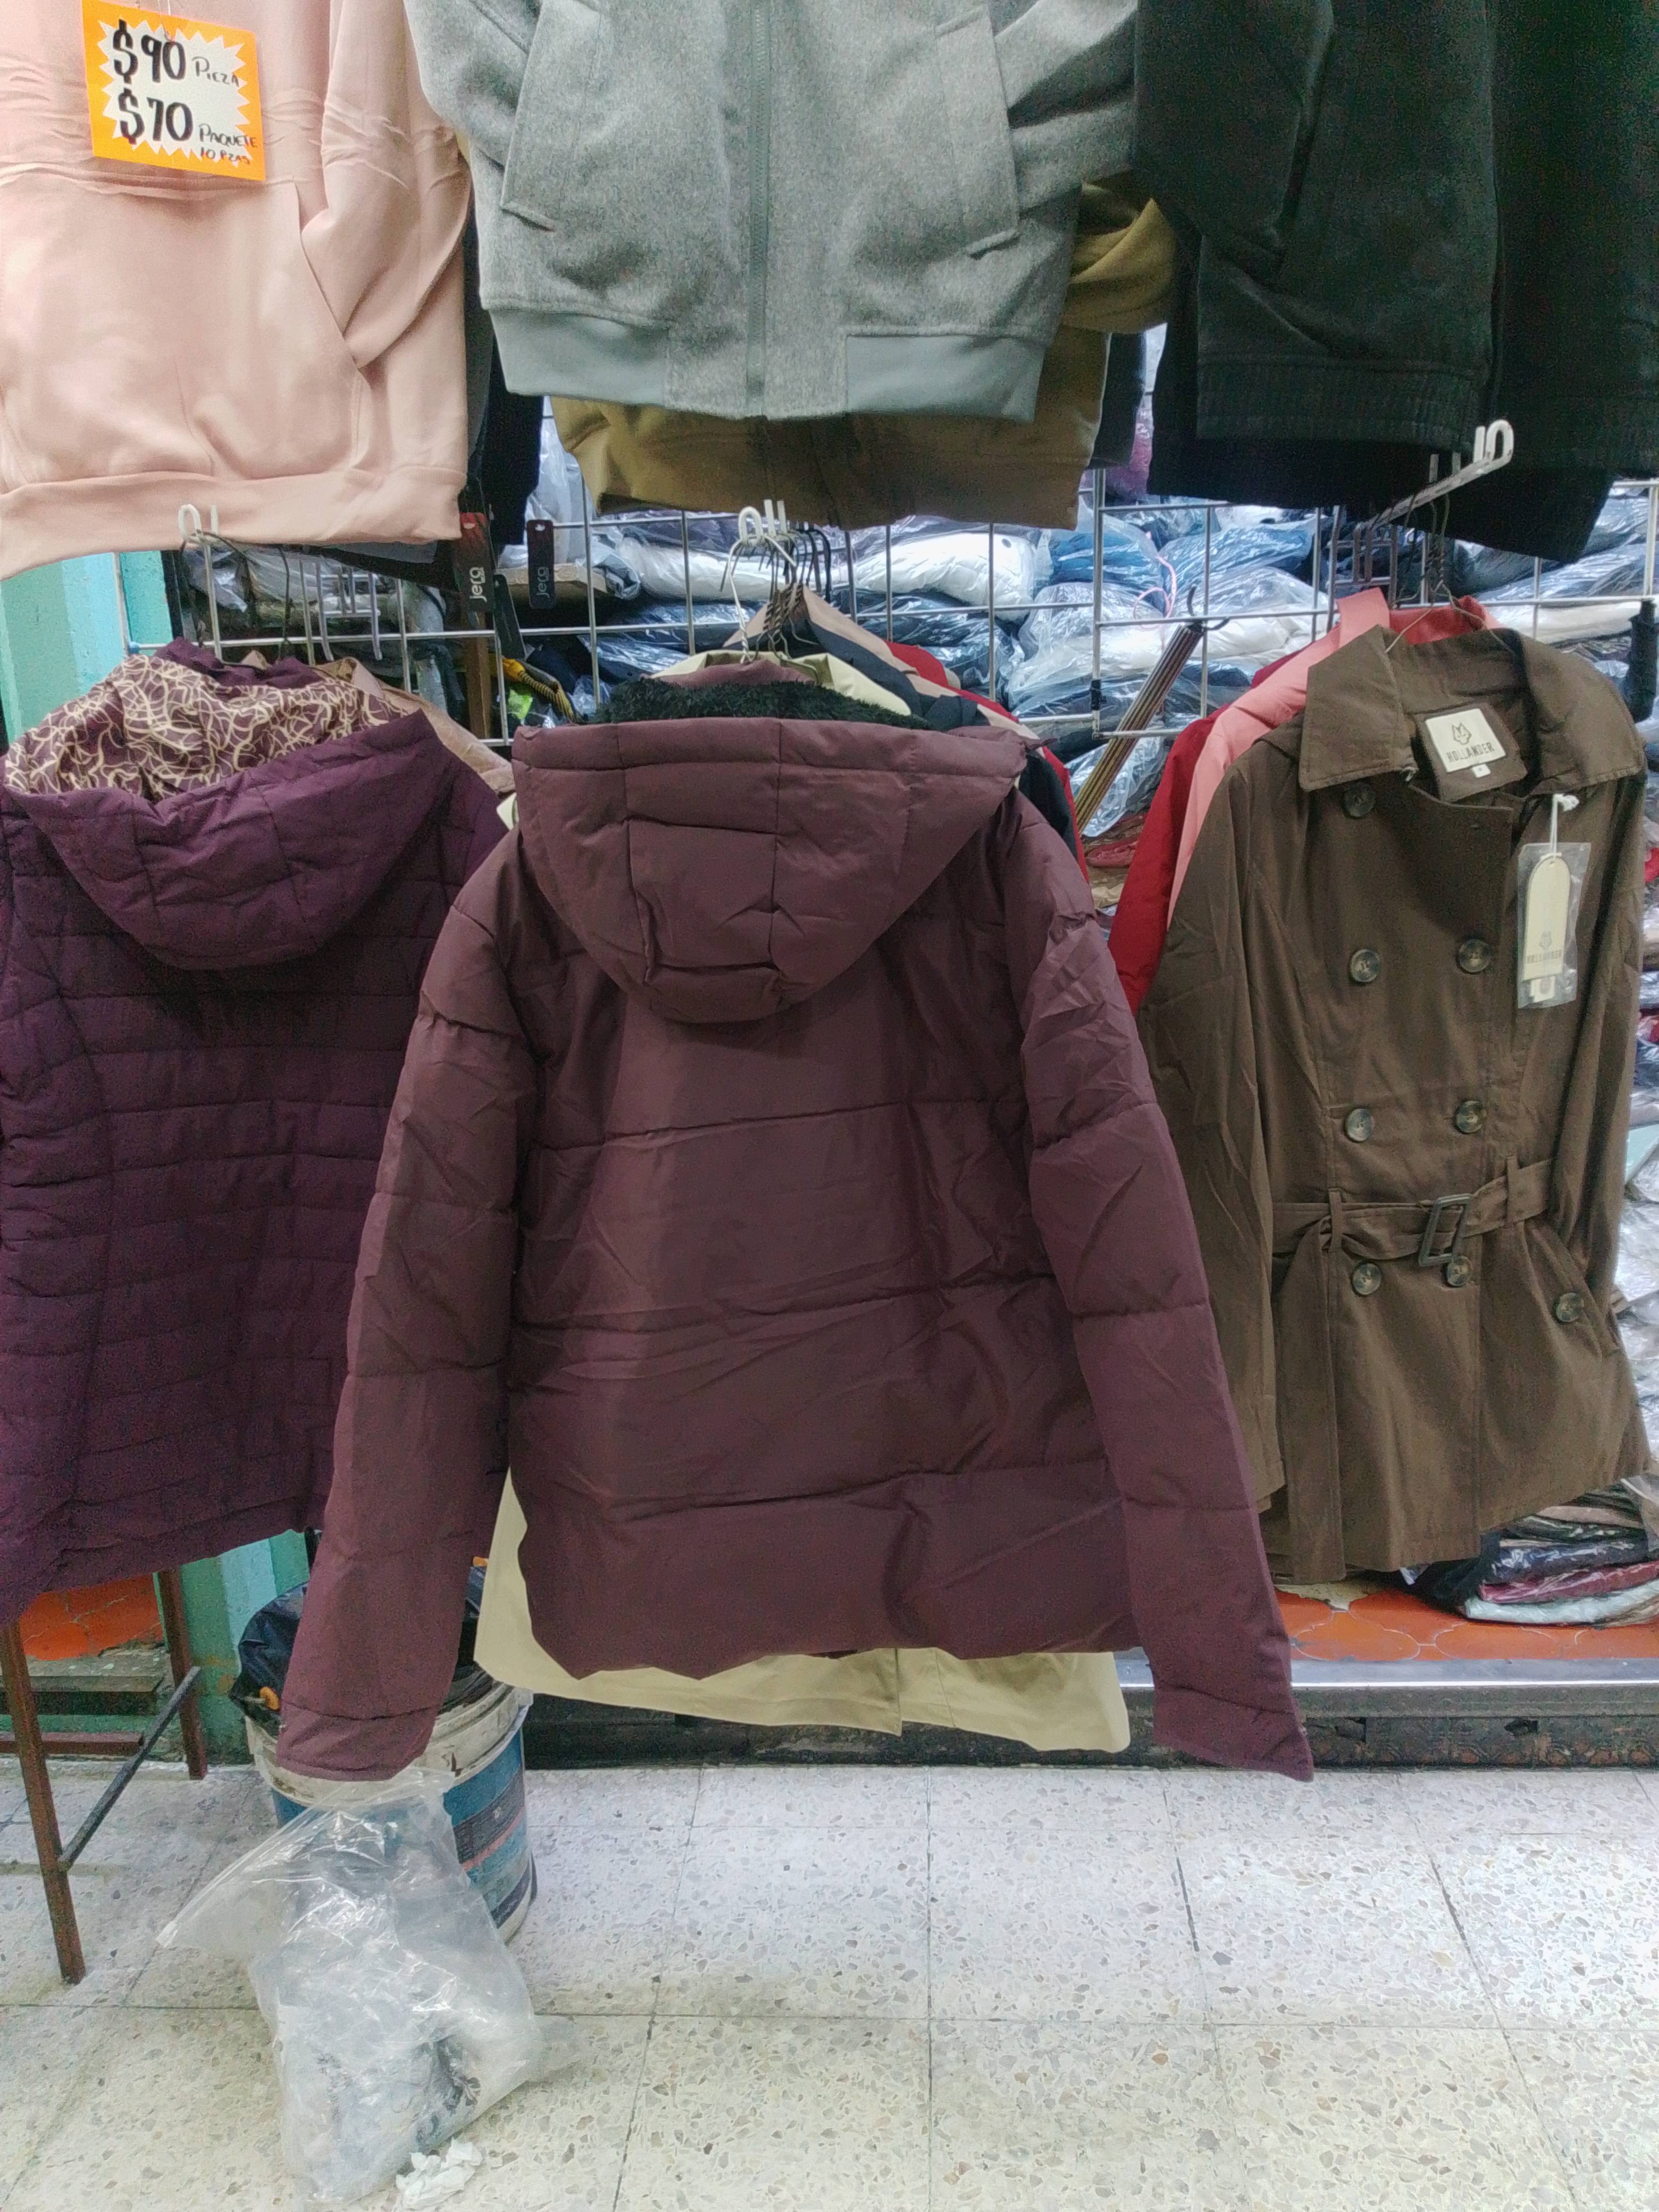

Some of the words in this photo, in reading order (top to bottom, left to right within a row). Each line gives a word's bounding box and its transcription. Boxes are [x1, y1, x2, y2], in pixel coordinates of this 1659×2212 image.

[112, 19, 186, 83] $90
[118, 88, 193, 145] $70
[200, 147, 215, 160] 10
